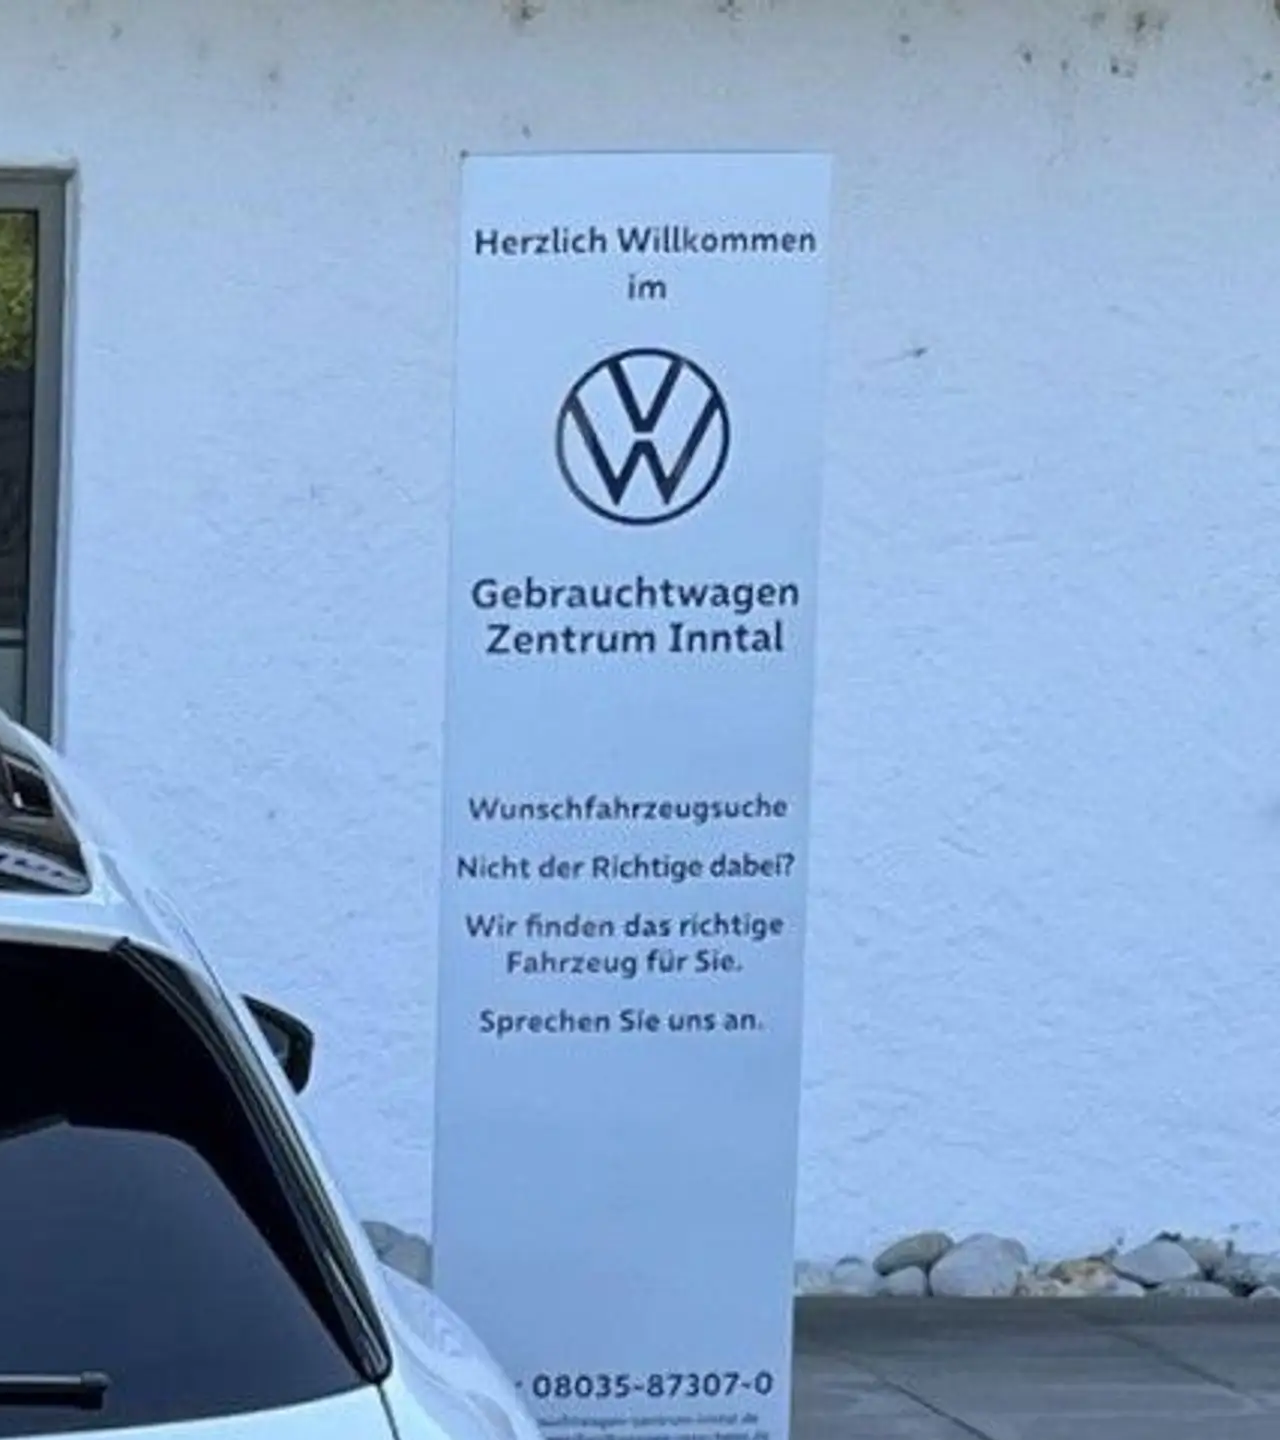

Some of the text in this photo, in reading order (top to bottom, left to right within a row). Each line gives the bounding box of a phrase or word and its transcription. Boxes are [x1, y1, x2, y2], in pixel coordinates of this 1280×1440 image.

[475, 224, 816, 256] Herzlich Willkommen
[628, 273, 667, 300] im
[471, 575, 799, 616] Gebrauchtwagen
[486, 619, 784, 655] Zentrum Inntal
[468, 792, 788, 826] Wunschfahrzeugsuche
[457, 852, 796, 884] Nicht der Richtige dabei?
[465, 911, 785, 942] Wir finden das richtige
[506, 948, 743, 980] Fahrzeug für Sie.
[479, 1008, 762, 1038] Sprechen Sie uns an.
[532, 1370, 774, 1400] 08035-87307-0
